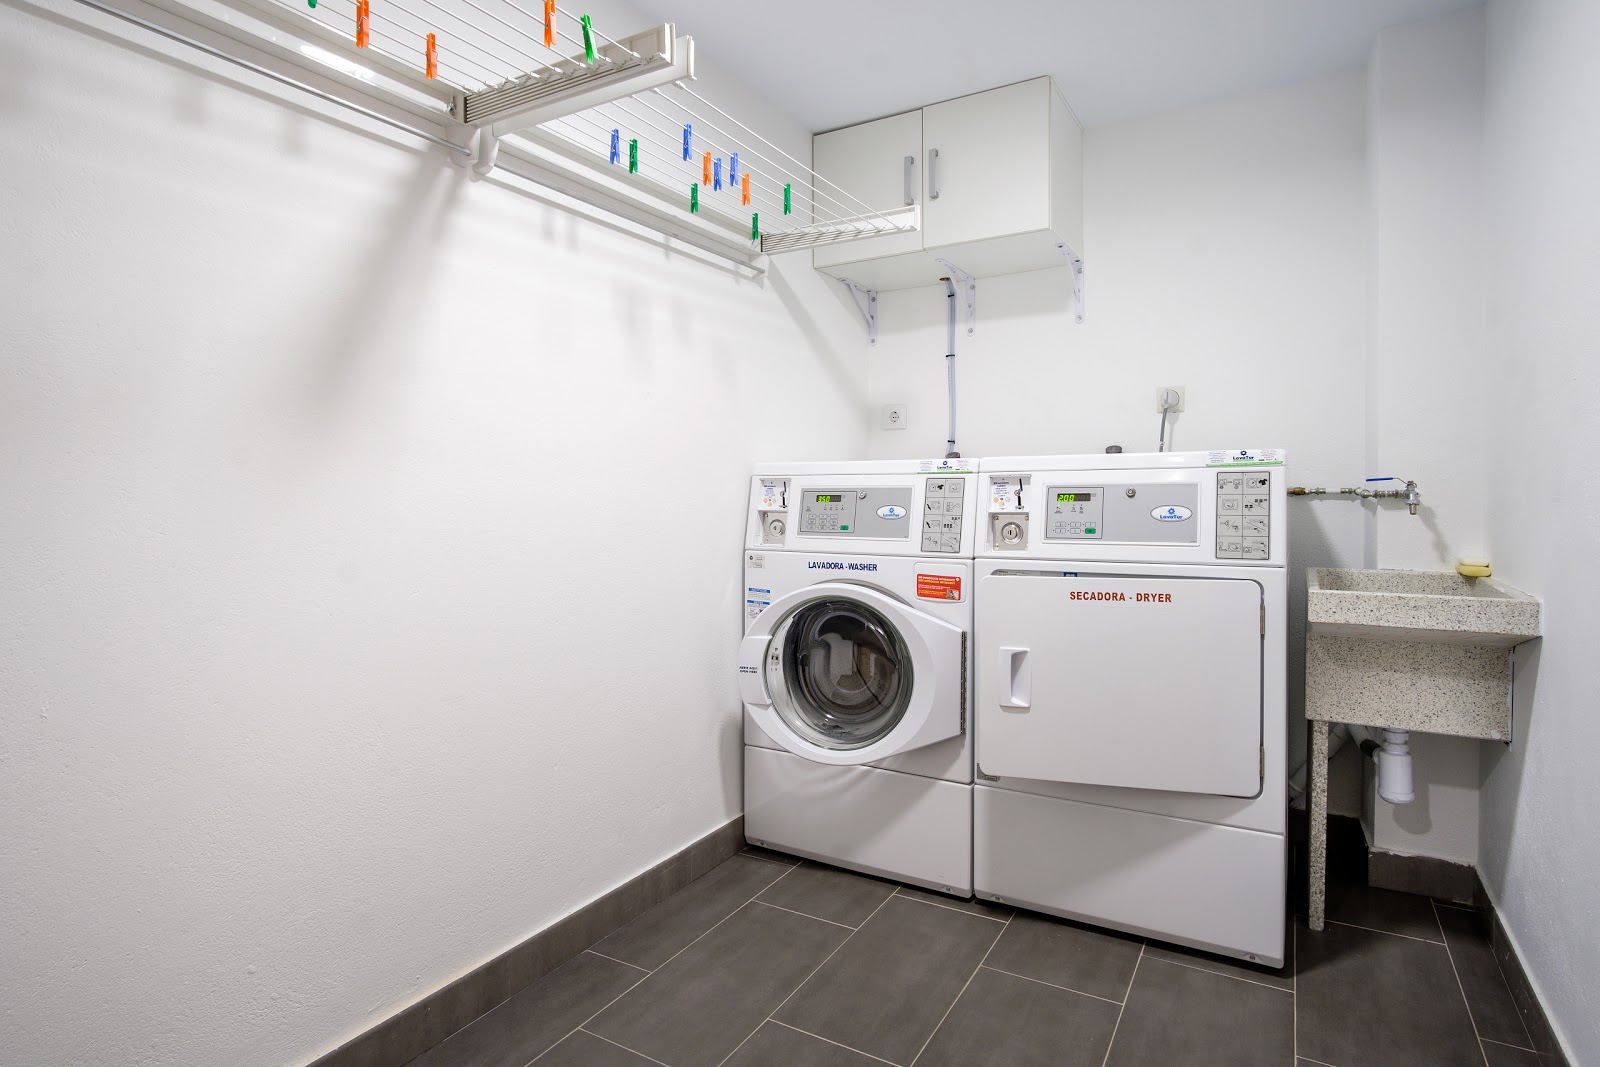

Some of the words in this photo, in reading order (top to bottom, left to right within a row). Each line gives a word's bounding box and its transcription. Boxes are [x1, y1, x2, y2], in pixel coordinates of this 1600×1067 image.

[808, 562, 844, 570] LAVADORA
[1069, 591, 1126, 602] SECADORA
[1136, 592, 1172, 603] DRYER
